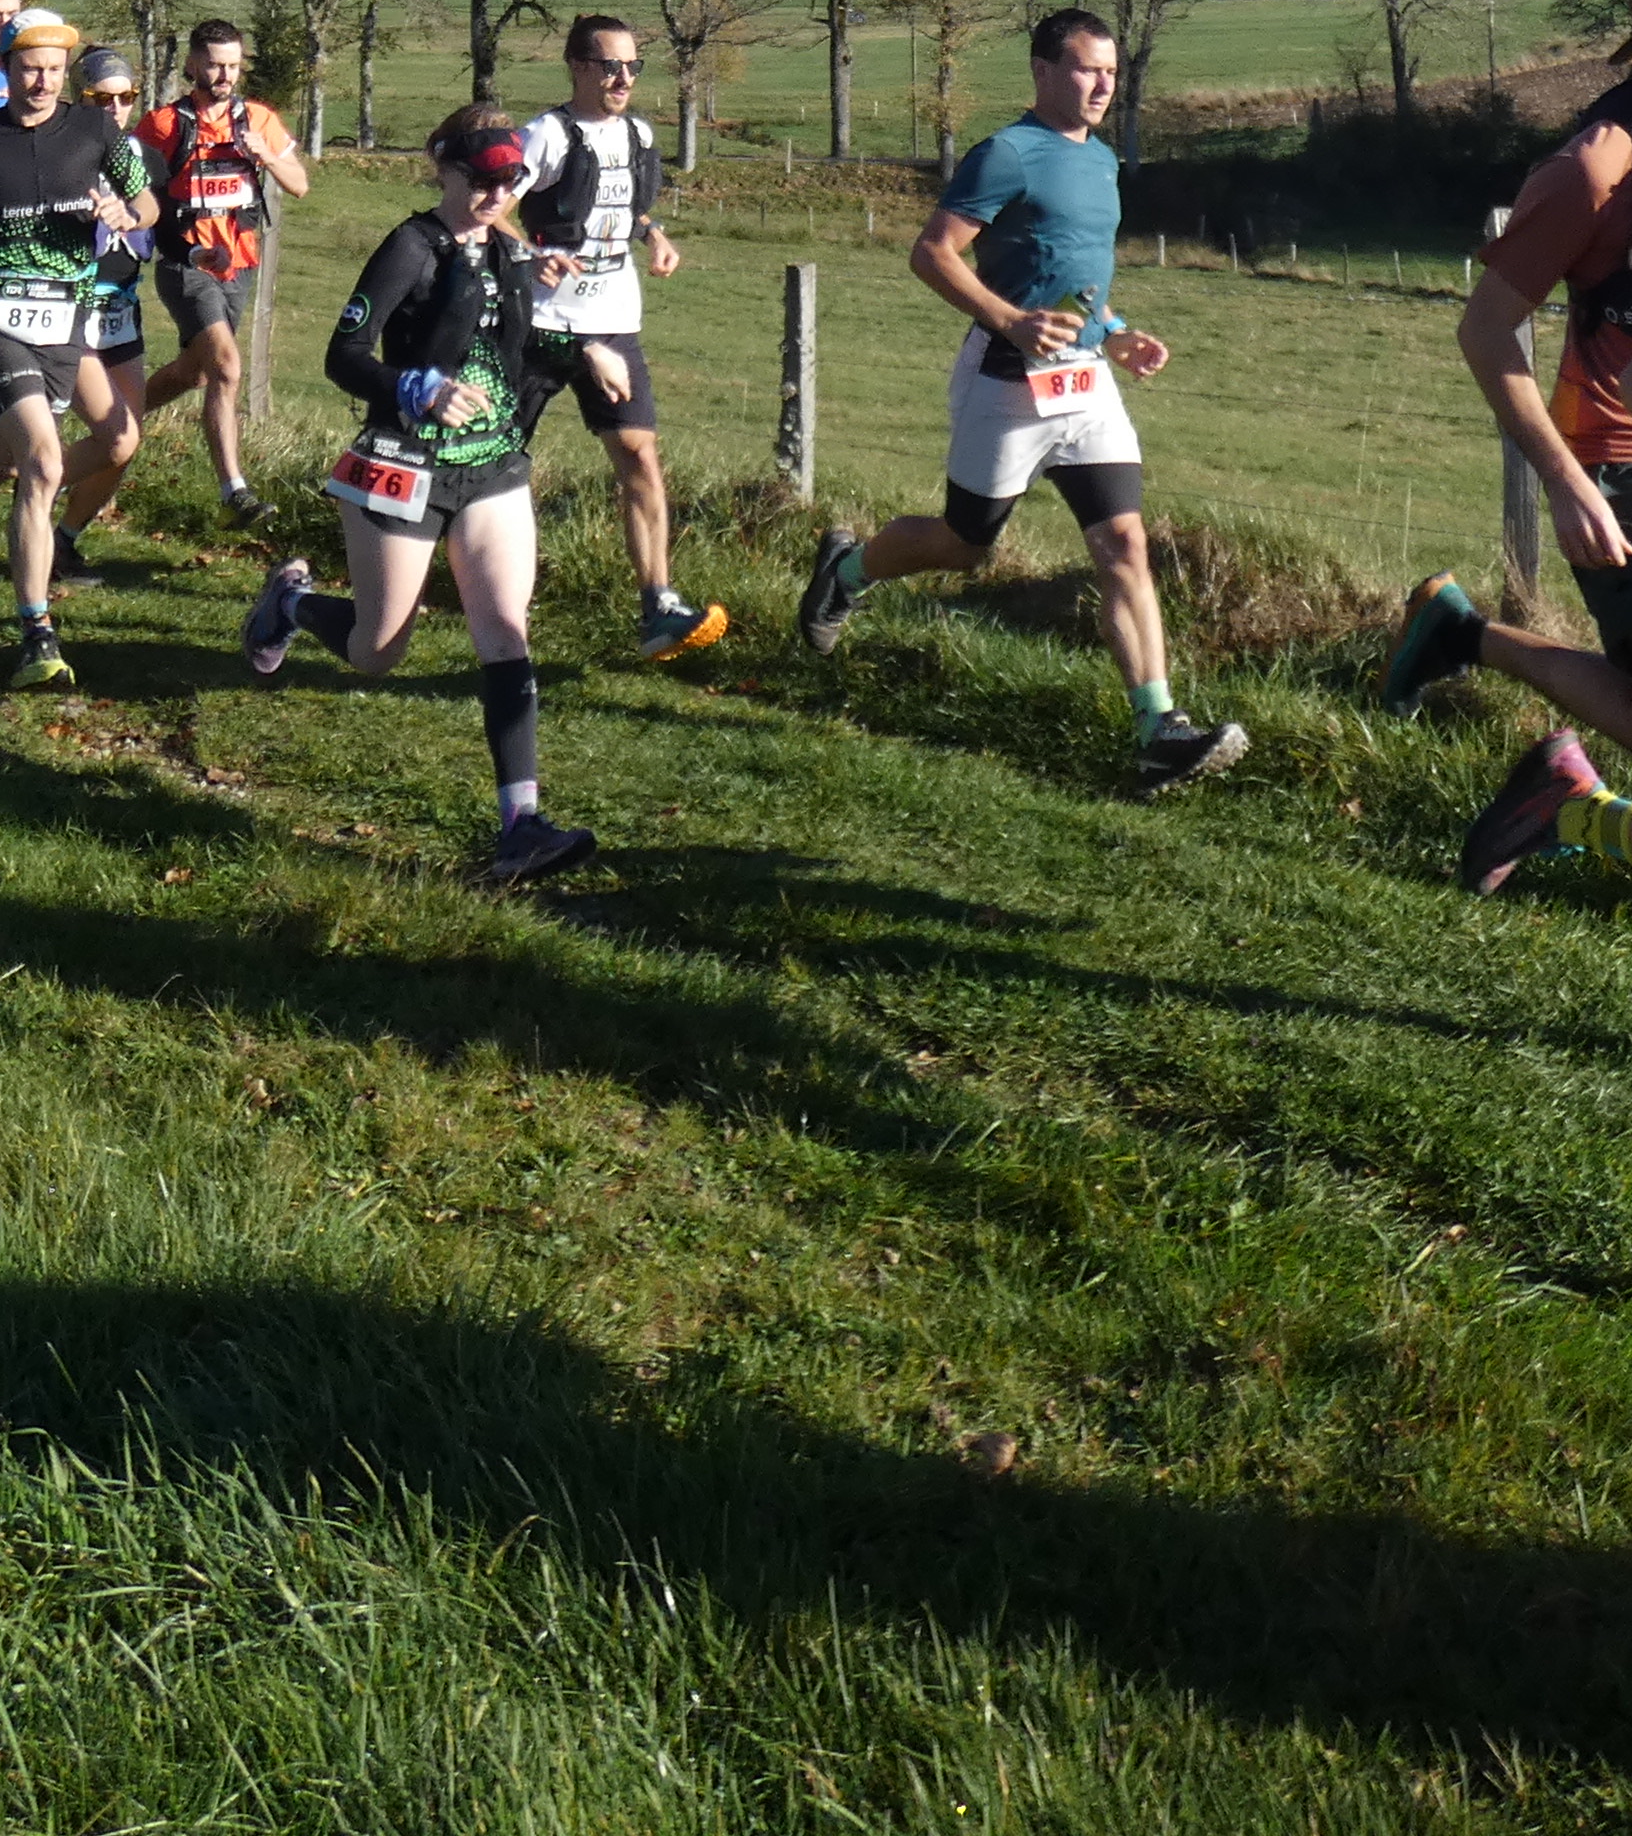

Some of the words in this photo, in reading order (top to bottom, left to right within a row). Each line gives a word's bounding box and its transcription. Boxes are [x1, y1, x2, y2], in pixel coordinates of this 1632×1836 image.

[206, 179, 238, 196] 865
[3, 206, 34, 219] terre
[53, 196, 94, 213] running
[574, 279, 608, 298] 850
[8, 307, 52, 328] 876
[348, 462, 403, 498] 876
